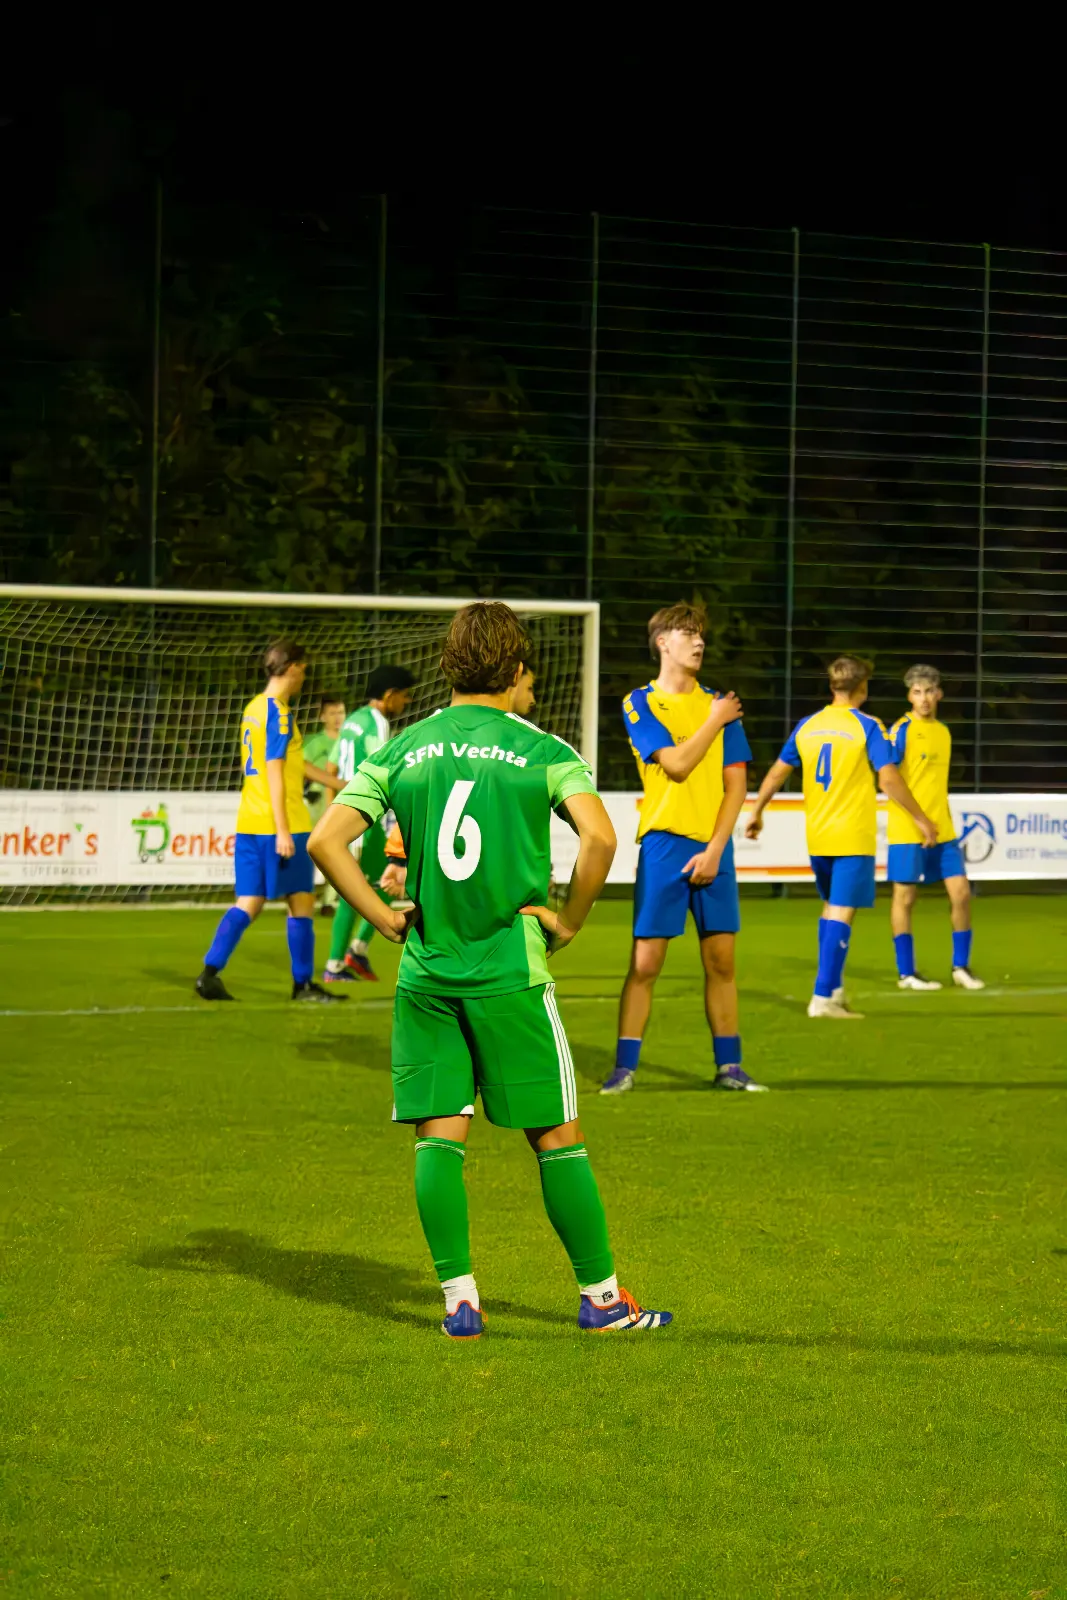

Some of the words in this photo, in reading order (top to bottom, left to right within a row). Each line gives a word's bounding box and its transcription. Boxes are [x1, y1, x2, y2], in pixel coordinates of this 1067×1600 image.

[243, 728, 259, 776] 2
[404, 742, 444, 769] SFN
[450, 743, 528, 768] Vechta
[815, 743, 832, 792] 4
[0, 823, 99, 856] nker's
[437, 780, 482, 882] 6
